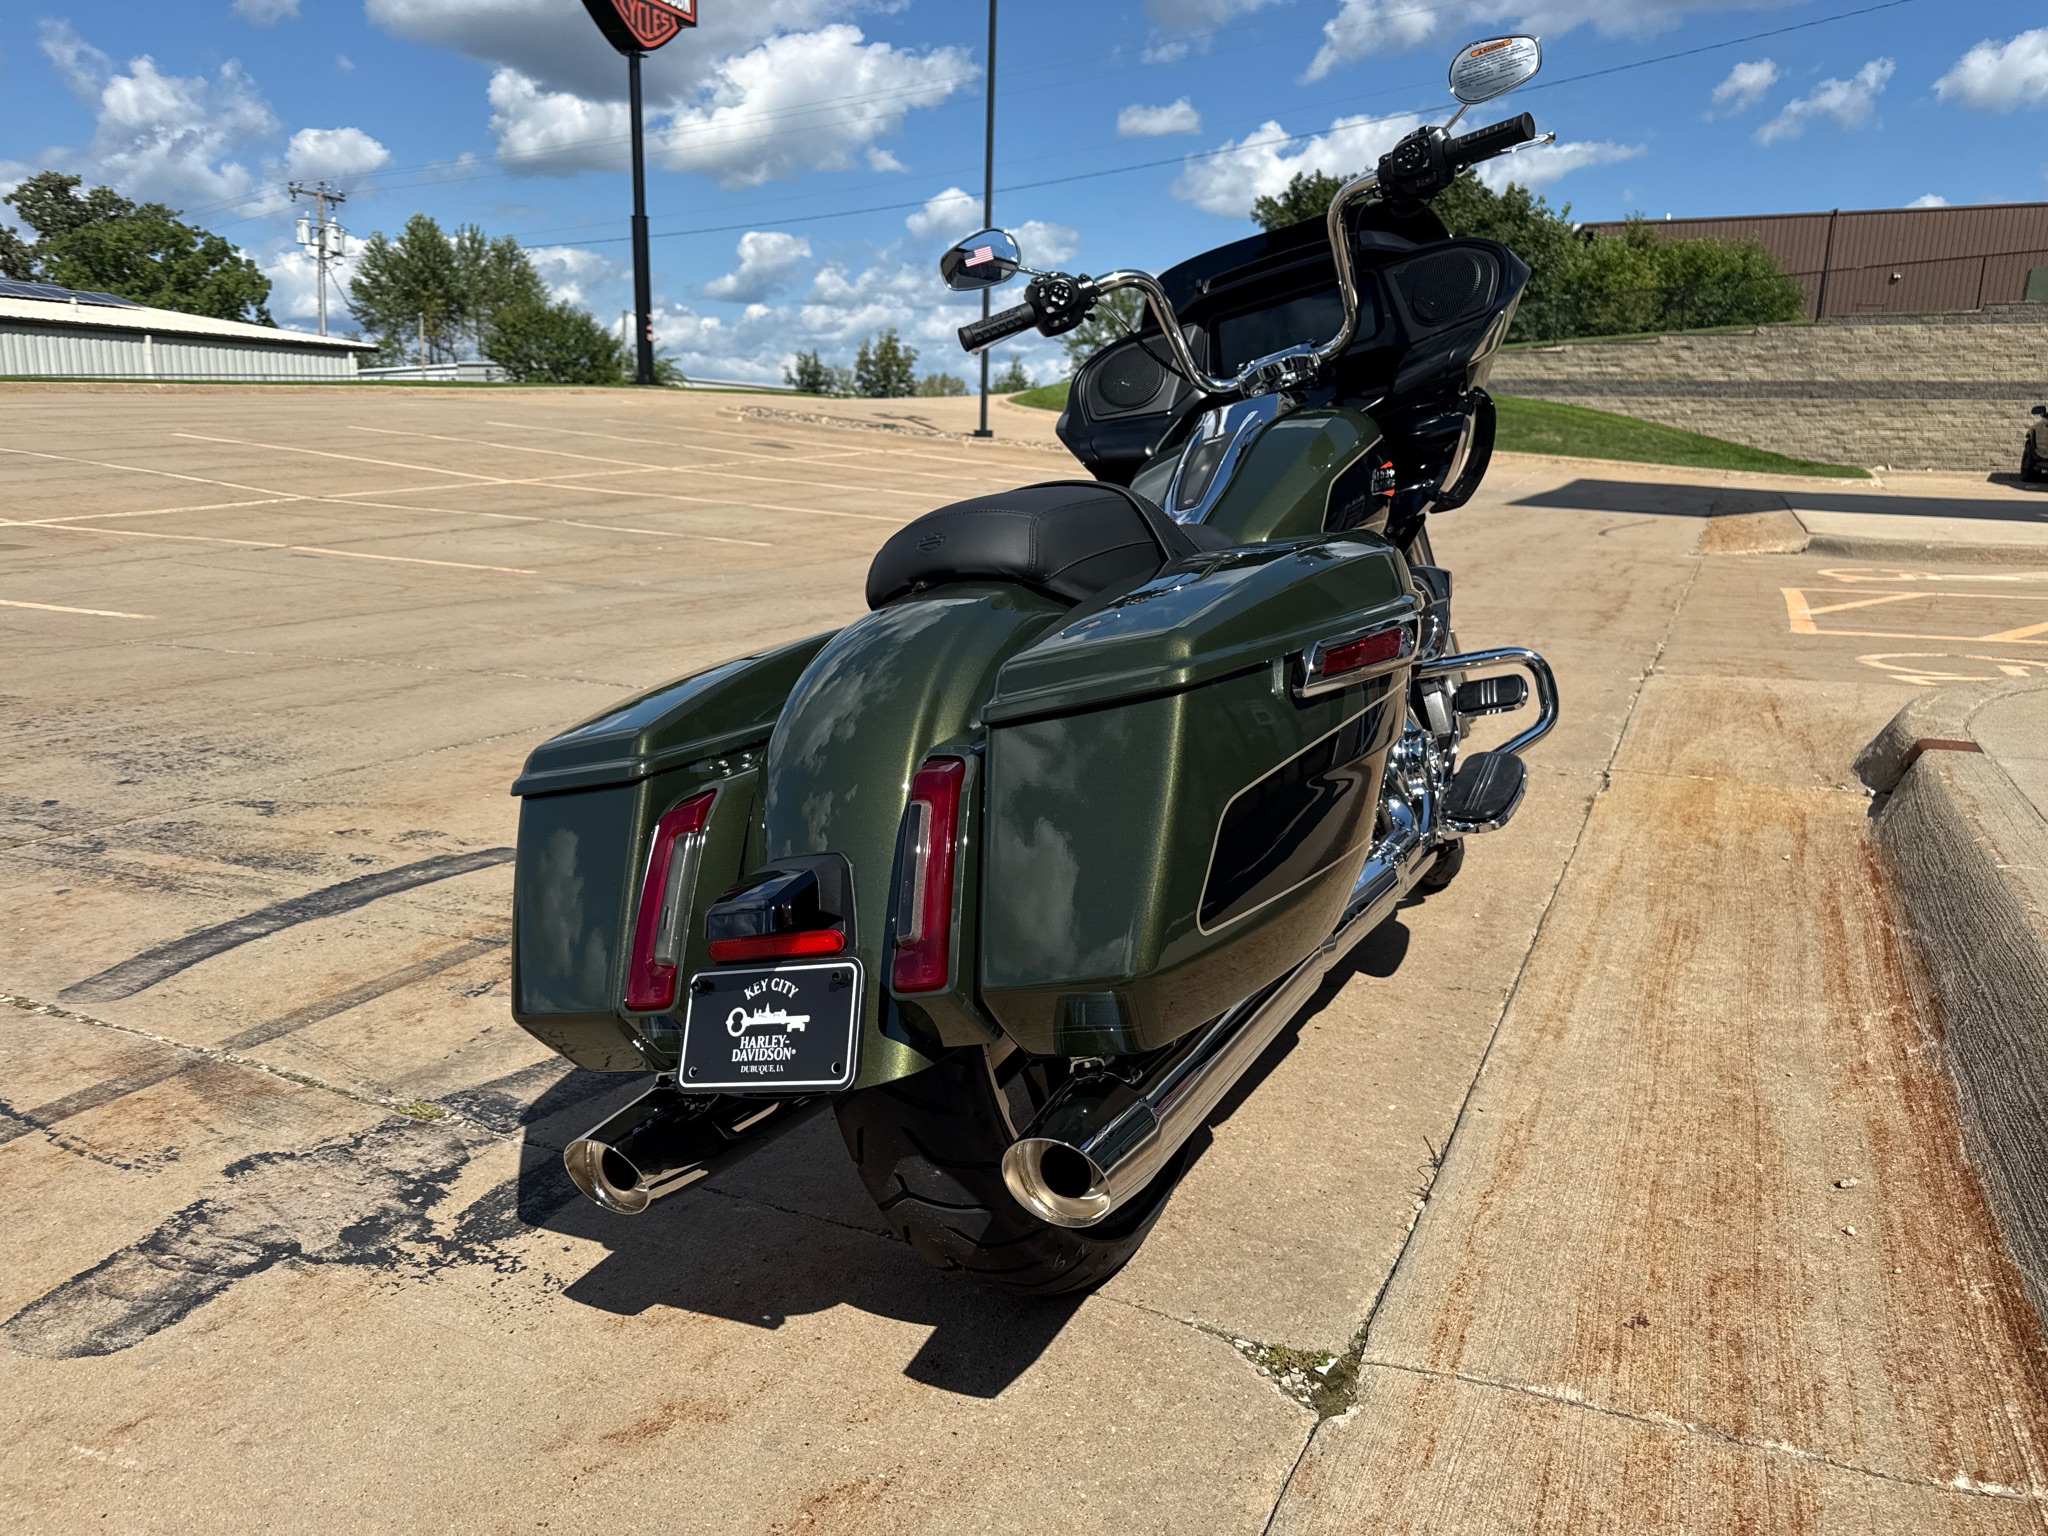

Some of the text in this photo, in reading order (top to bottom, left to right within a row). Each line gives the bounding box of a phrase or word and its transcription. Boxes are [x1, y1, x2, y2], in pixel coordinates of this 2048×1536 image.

[743, 977, 799, 1001] KEY CITY
[739, 1034, 790, 1049] HARLEY-
[740, 1064, 776, 1075] DUBUQUE,
